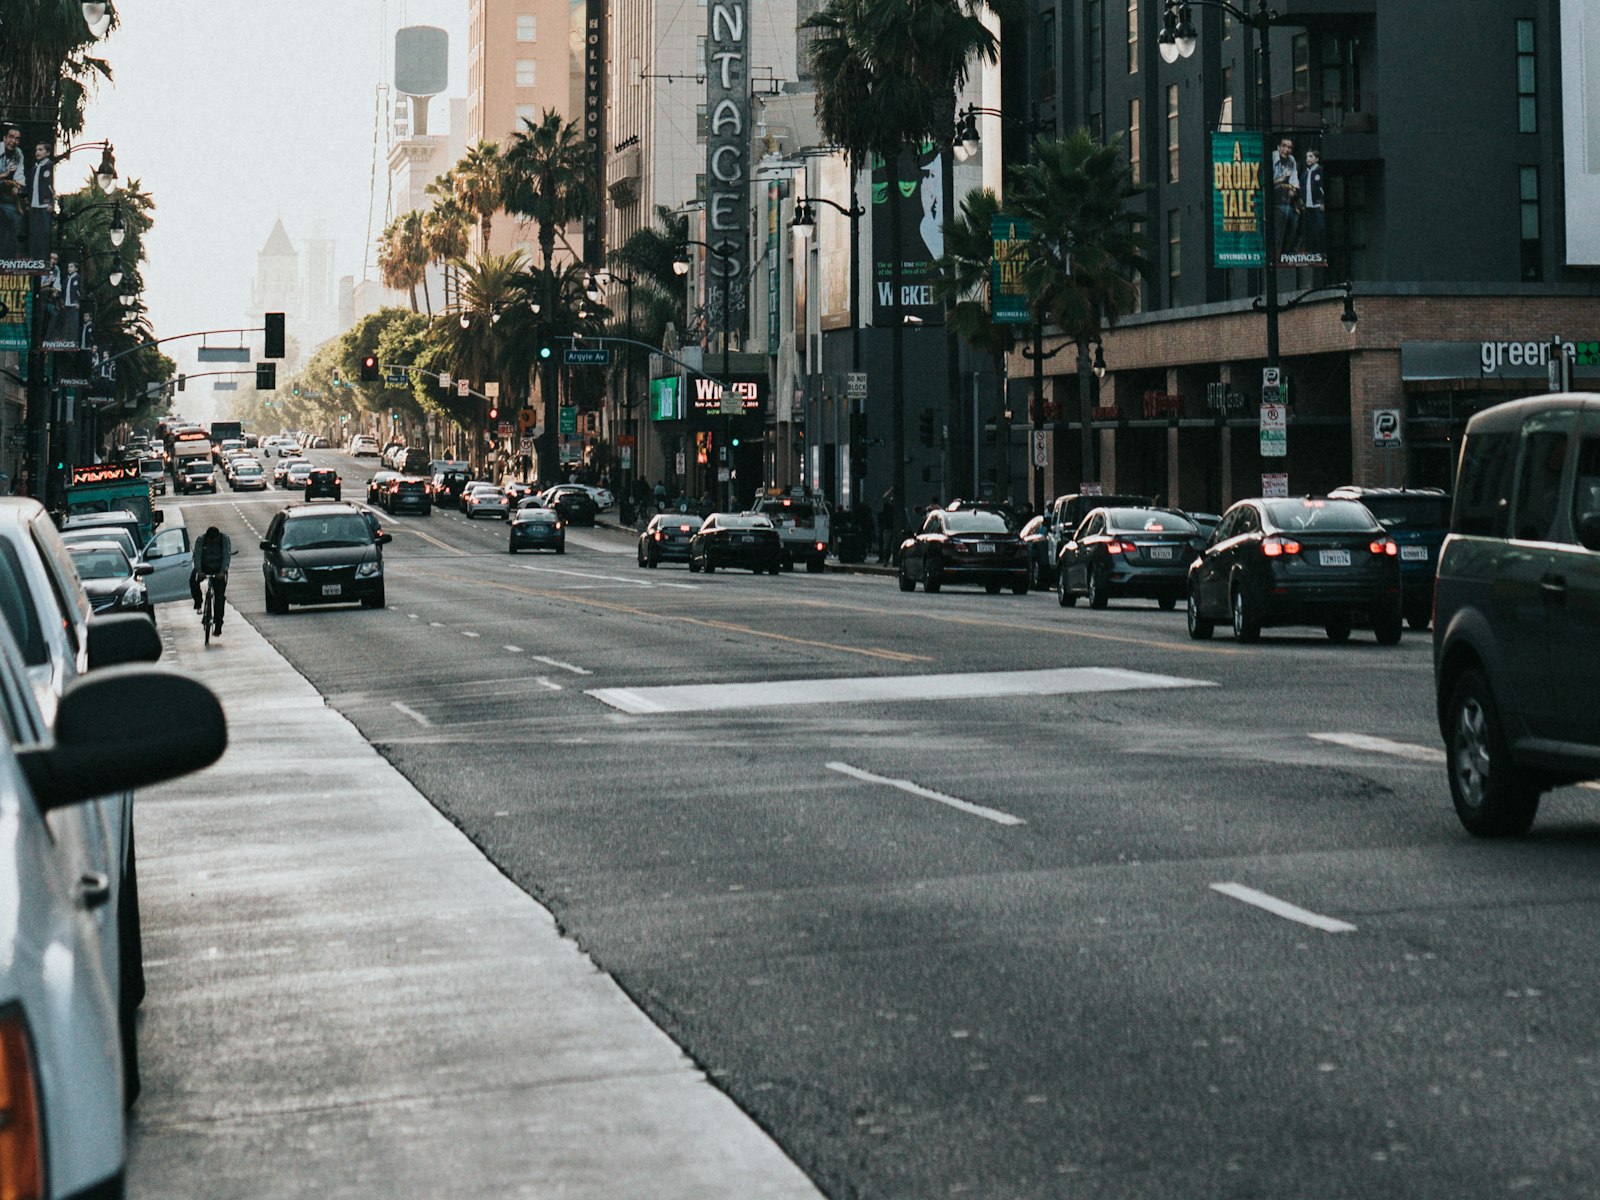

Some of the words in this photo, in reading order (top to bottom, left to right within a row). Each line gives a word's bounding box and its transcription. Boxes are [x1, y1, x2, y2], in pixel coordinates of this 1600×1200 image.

[1233, 141, 1241, 160] A
[1214, 162, 1260, 189] BRONX
[1221, 190, 1255, 217] TALE
[1008, 222, 1015, 238] A
[1281, 253, 1322, 262] PANTAGES
[568, 353, 592, 361] Argyle
